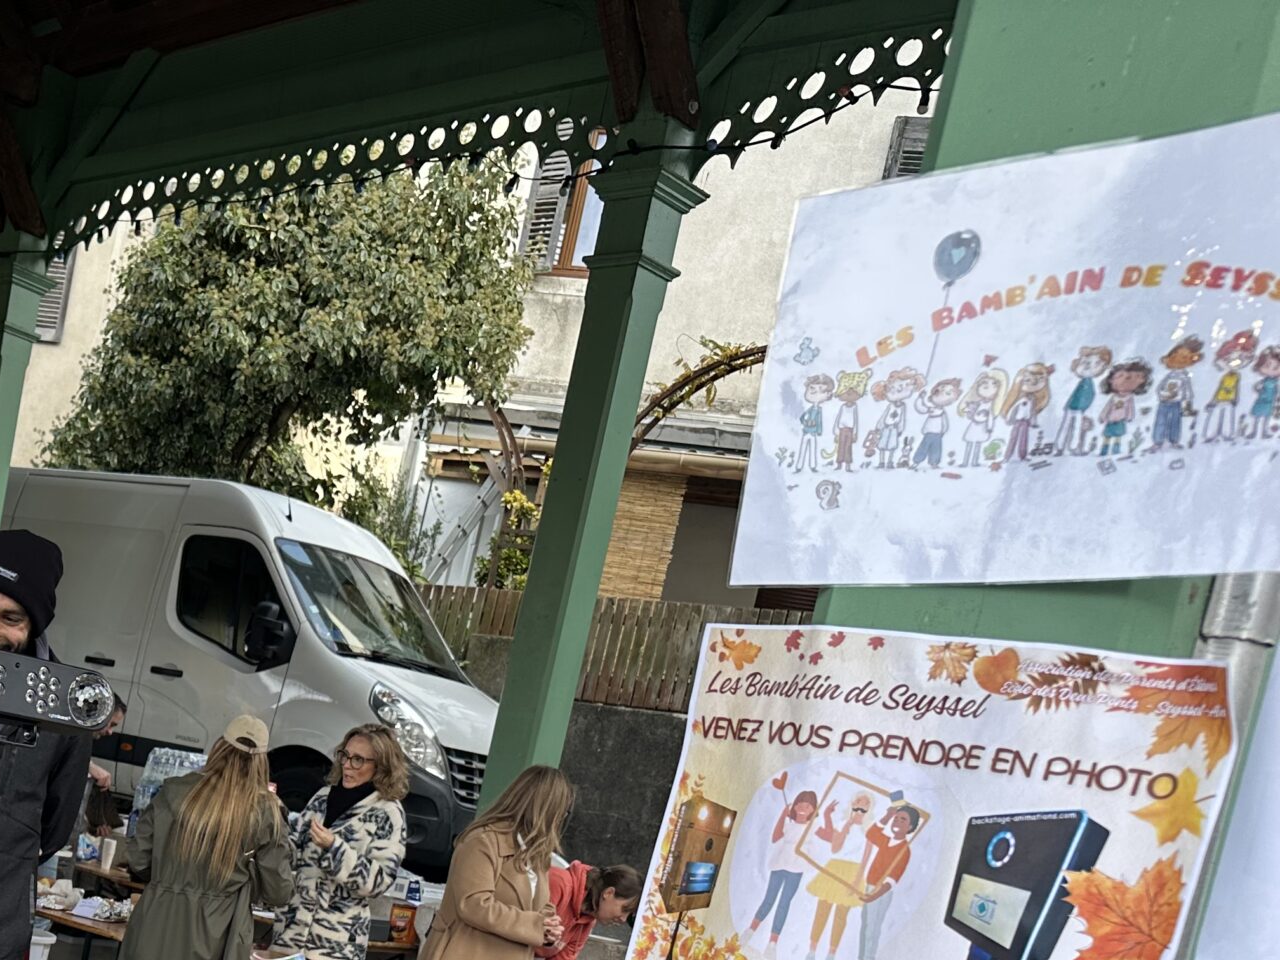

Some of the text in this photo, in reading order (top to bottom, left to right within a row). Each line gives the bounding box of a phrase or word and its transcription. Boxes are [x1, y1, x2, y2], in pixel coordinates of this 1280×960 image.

[855, 325, 916, 368] LES
[930, 266, 1106, 332] BAMB'AIN
[1120, 264, 1167, 288] DE
[705, 671, 991, 720] Les Bamb'Ain de Seyssel
[701, 715, 1178, 800] VENEZ VOUS PRENDRE EN PHOTO
